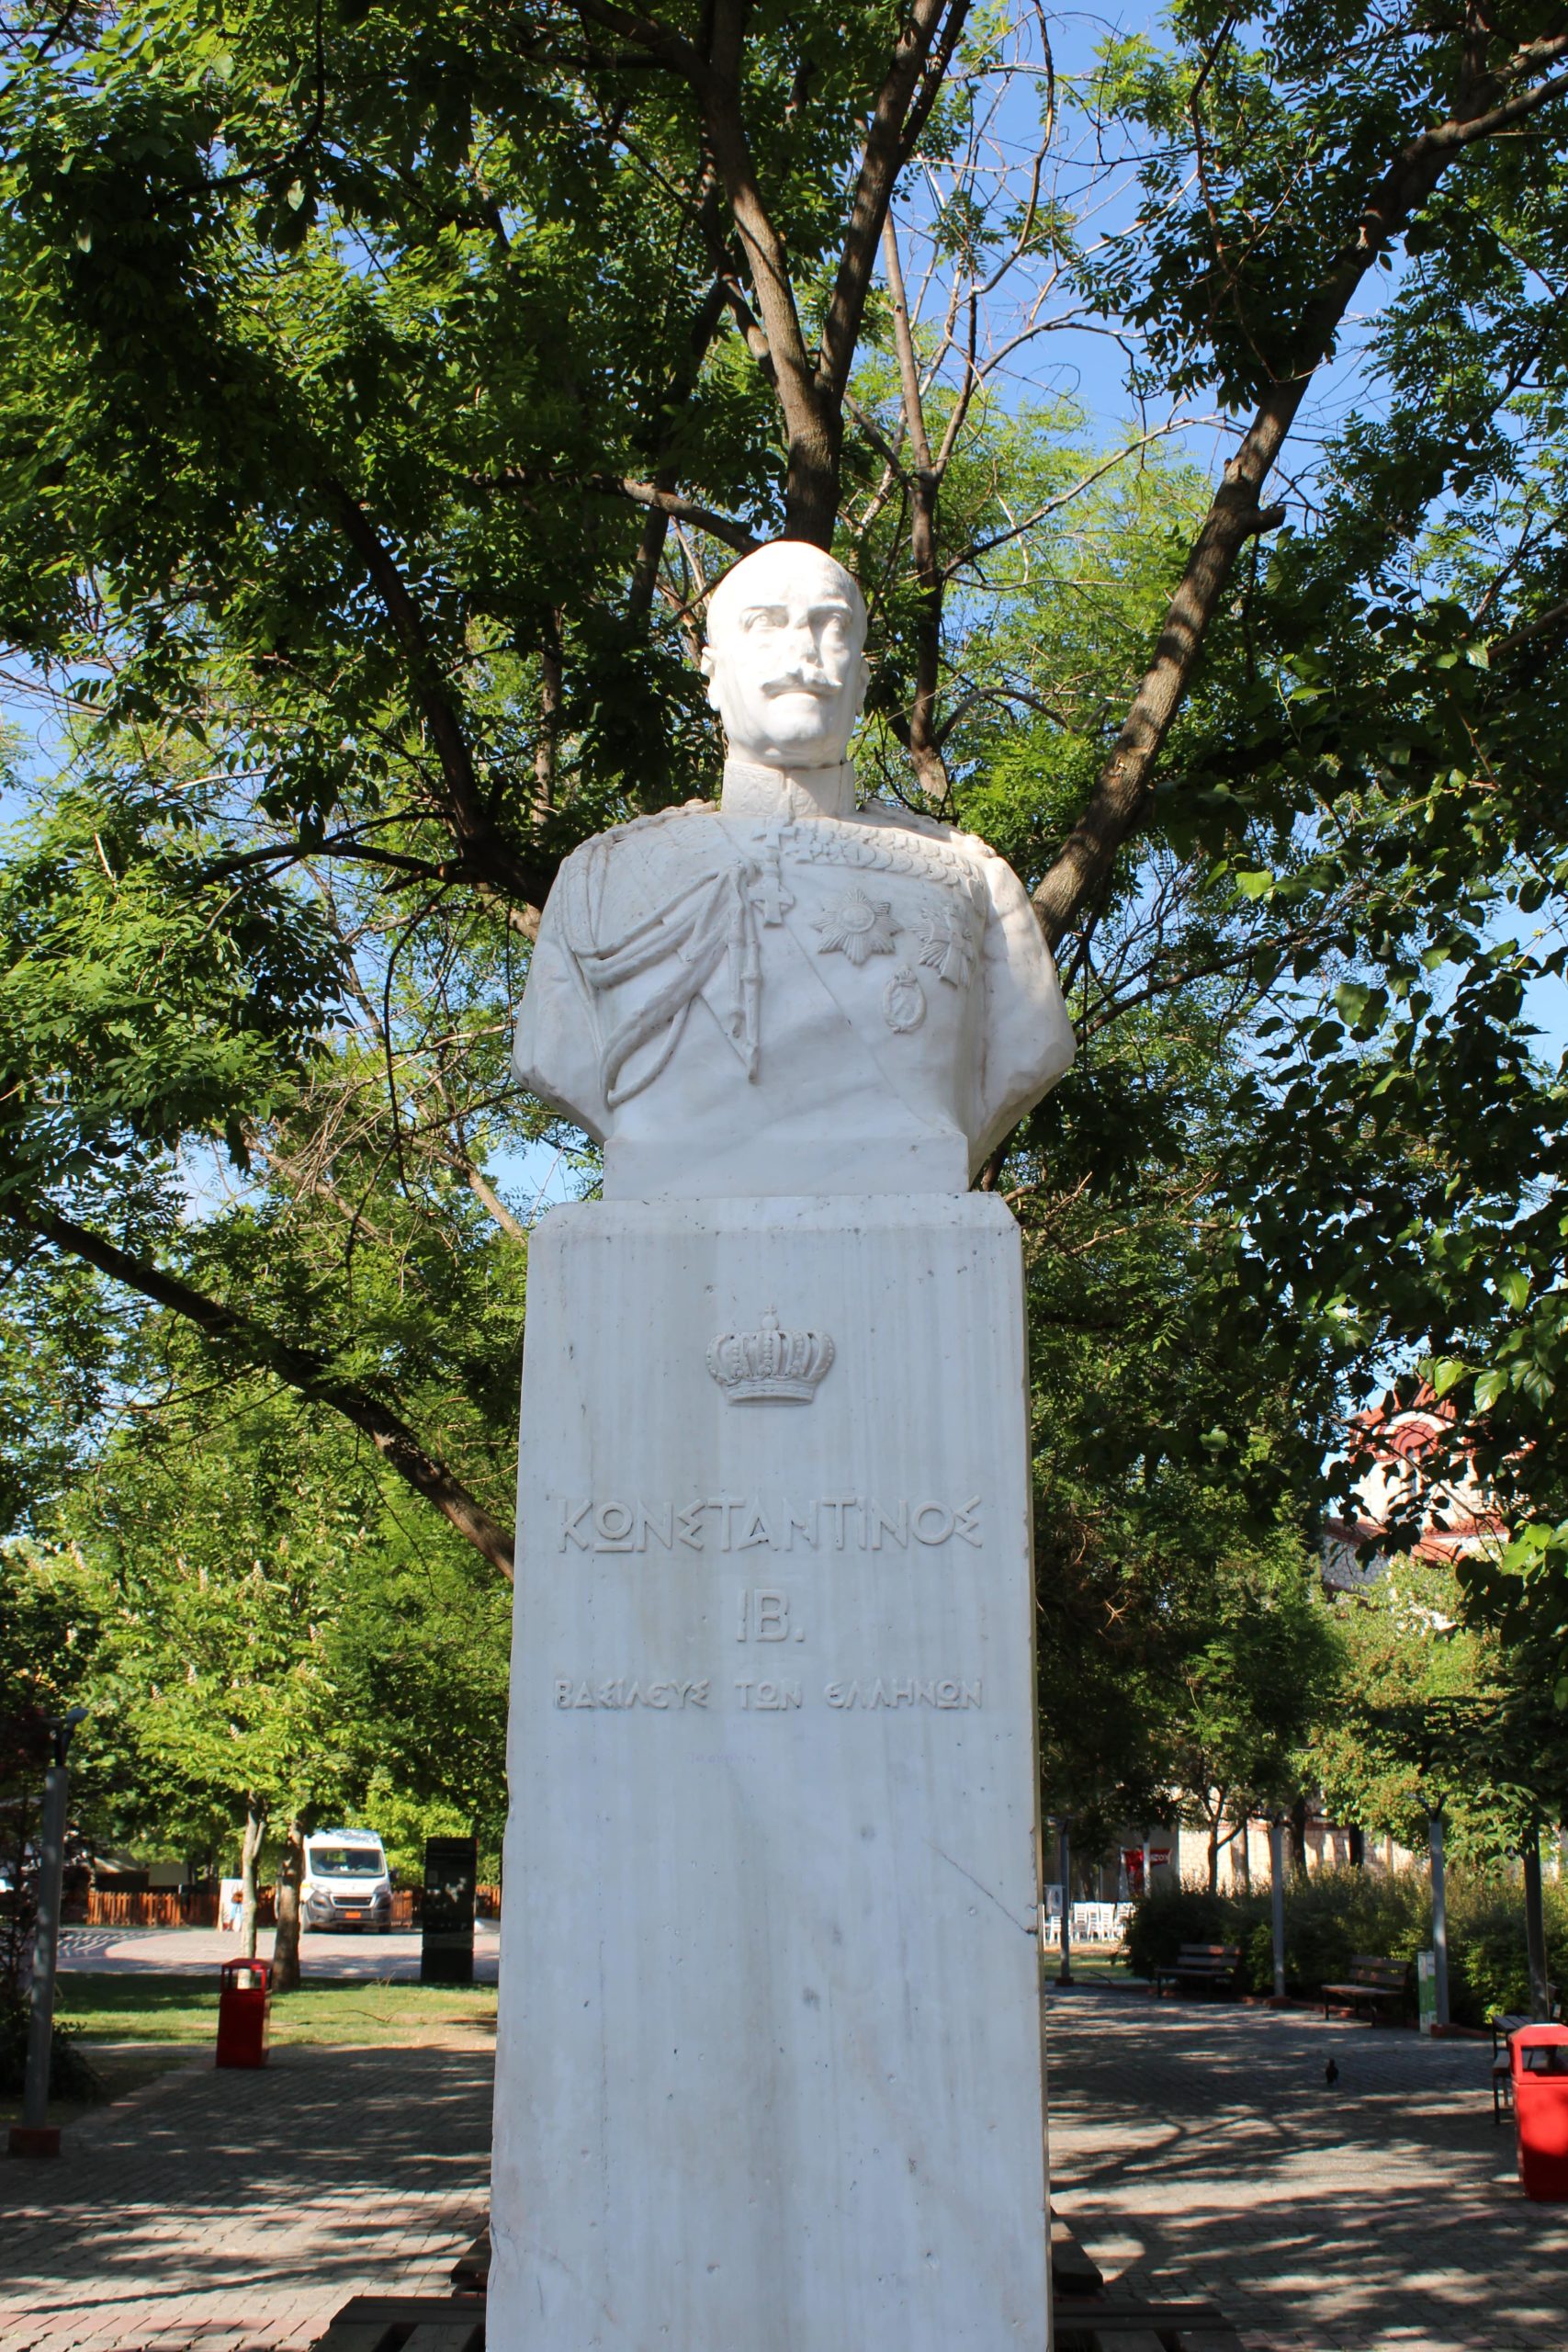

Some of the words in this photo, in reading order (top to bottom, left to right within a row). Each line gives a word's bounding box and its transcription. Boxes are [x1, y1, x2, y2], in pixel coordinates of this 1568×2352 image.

[557, 1494, 984, 1553] ΚΩΝΣΤΑΝΤΙΝΟΣ
[735, 1679, 803, 1711] ΤΩΝ
[825, 1678, 983, 1711] ΕΛΛΗΝΩΝ
